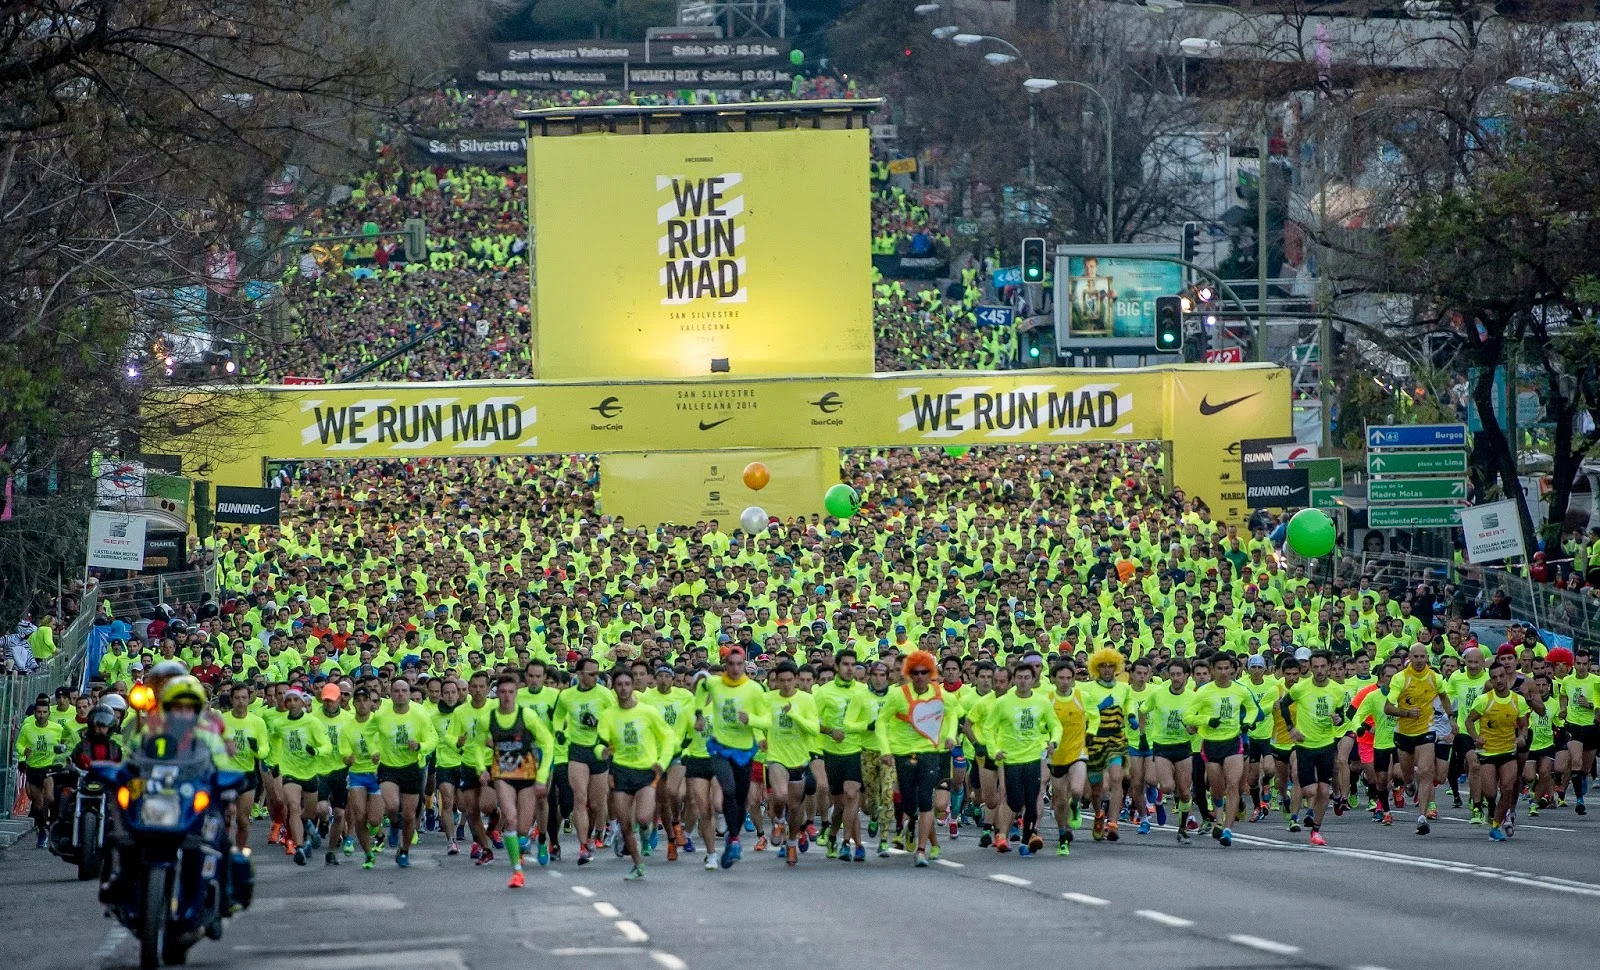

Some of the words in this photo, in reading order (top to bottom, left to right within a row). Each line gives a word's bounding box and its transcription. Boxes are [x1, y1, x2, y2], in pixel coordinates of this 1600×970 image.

[508, 49, 530, 60] San
[530, 48, 577, 59] Silvestre
[578, 47, 629, 58] Vallecana
[476, 70, 499, 81] San
[500, 70, 550, 81] Silvestre
[551, 70, 607, 81] Vallecana
[629, 69, 675, 81] WOMEN
[675, 69, 699, 81] BOX
[460, 139, 519, 152] Silvestre
[672, 177, 727, 217] WE
[667, 219, 735, 259] RUN
[666, 259, 739, 299] MAD
[1117, 301, 1140, 316] BIG
[691, 311, 739, 319] SILVESTRE
[678, 390, 696, 398] SAN
[702, 389, 755, 398] SILVESTRE
[676, 402, 732, 410] VALLECANA
[911, 393, 963, 431] WE
[974, 391, 1038, 430] RUN
[1048, 390, 1118, 428] MAD
[314, 406, 368, 444] WE
[377, 404, 442, 443] RUN
[451, 402, 523, 442] MAD
[1435, 431, 1463, 439] Burgos
[1244, 452, 1274, 463] RUNNIN
[1220, 492, 1245, 500] MARCA
[1248, 485, 1290, 497] RUNNING
[217, 502, 260, 514] RUNNING
[1478, 528, 1506, 538] SEAT
[103, 538, 131, 546] SEAT
[1500, 538, 1517, 546] MOTOR
